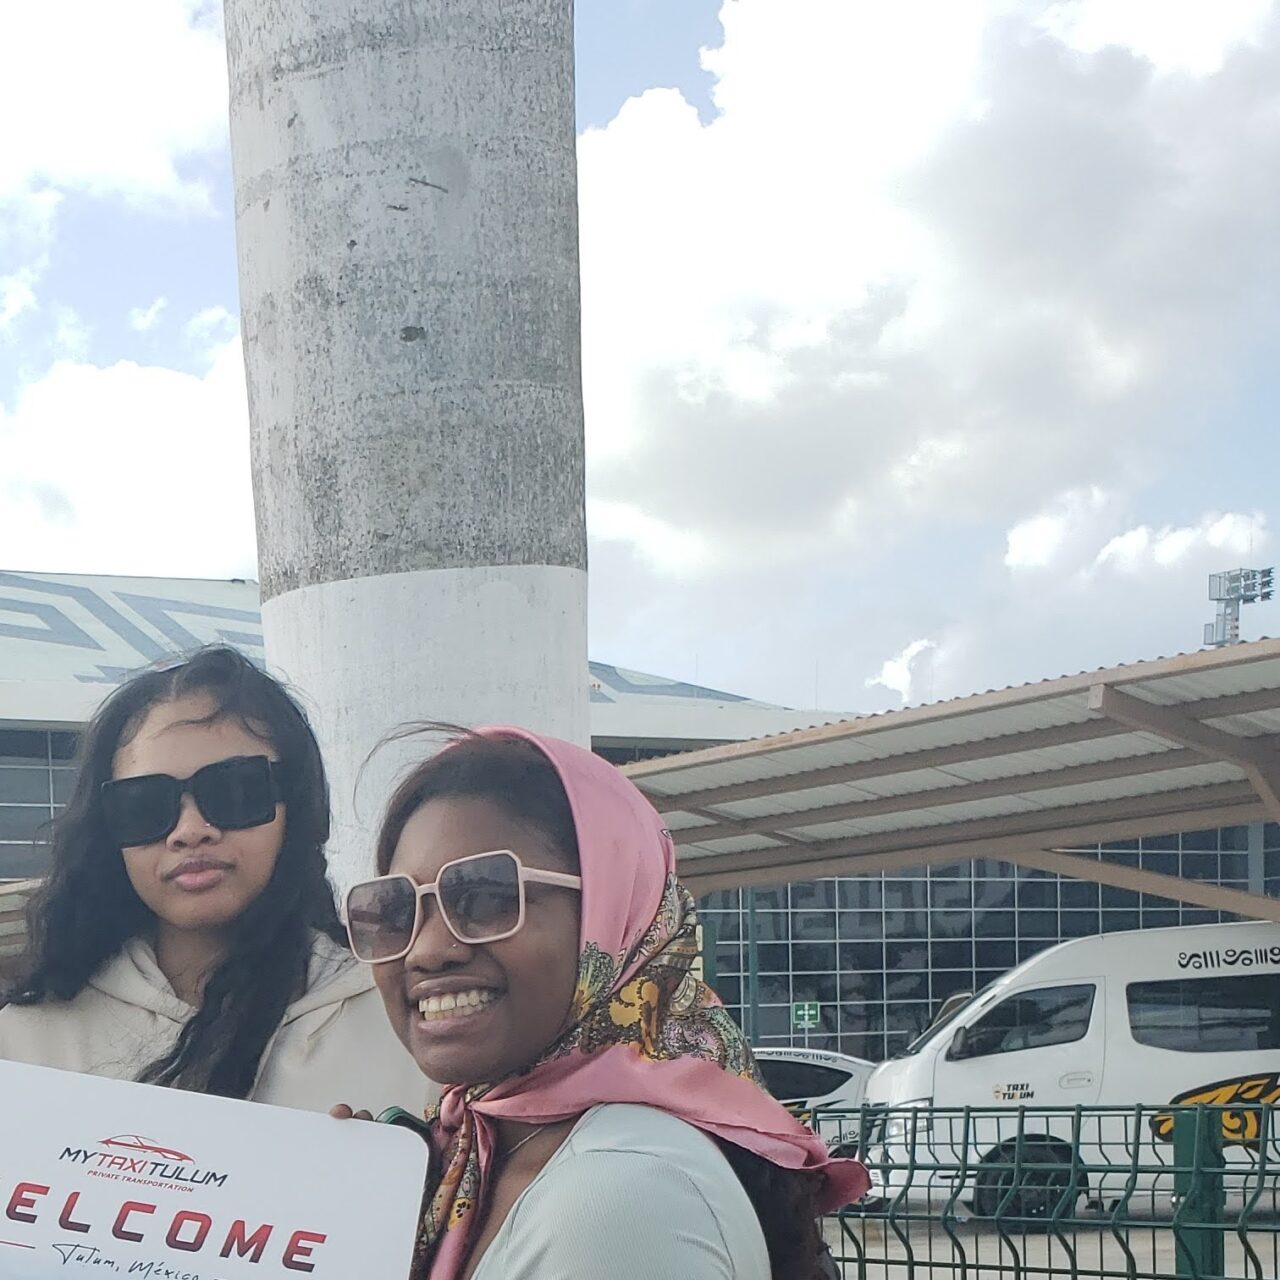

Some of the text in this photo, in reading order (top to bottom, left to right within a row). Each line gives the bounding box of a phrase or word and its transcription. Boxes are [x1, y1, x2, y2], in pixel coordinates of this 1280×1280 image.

[1002, 1091, 1034, 1100] TULUM
[1006, 1083, 1029, 1091] TAXI
[58, 1146, 229, 1188] MYTAXITULUM
[86, 1169, 195, 1194] PRIVATE TRANSPORTATION
[51, 1242, 121, 1273] Tulum,
